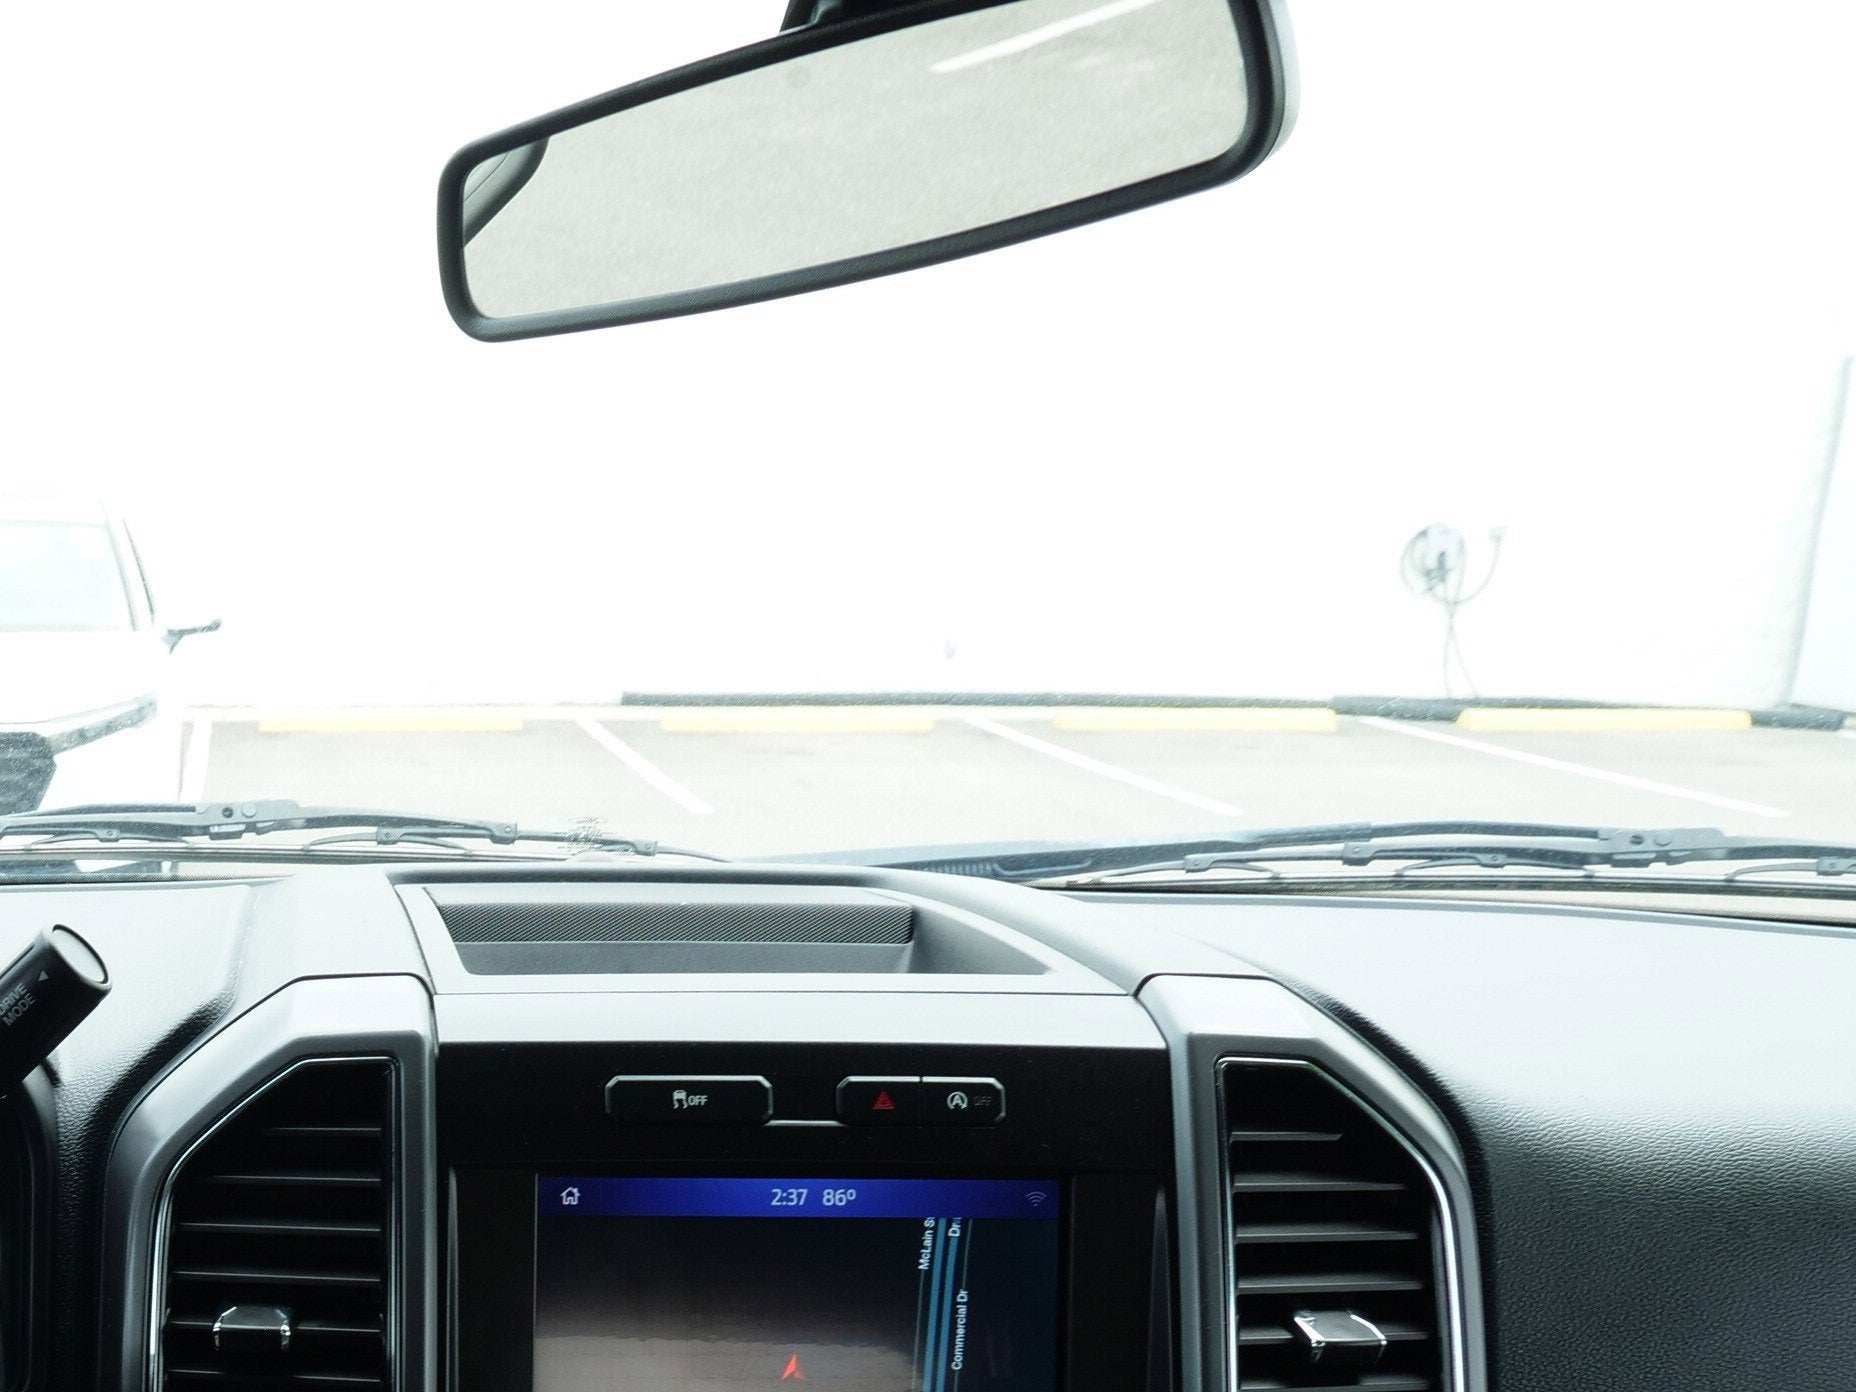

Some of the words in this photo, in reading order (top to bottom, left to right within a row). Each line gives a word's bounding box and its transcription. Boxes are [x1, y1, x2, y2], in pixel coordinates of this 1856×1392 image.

[2, 990, 37, 1026] MODE
[688, 1094, 708, 1106] OFF
[770, 1188, 808, 1206] 2:37
[918, 1230, 934, 1270] McLain
[956, 1288, 969, 1302] Dr
[950, 1304, 968, 1371] Commercial
